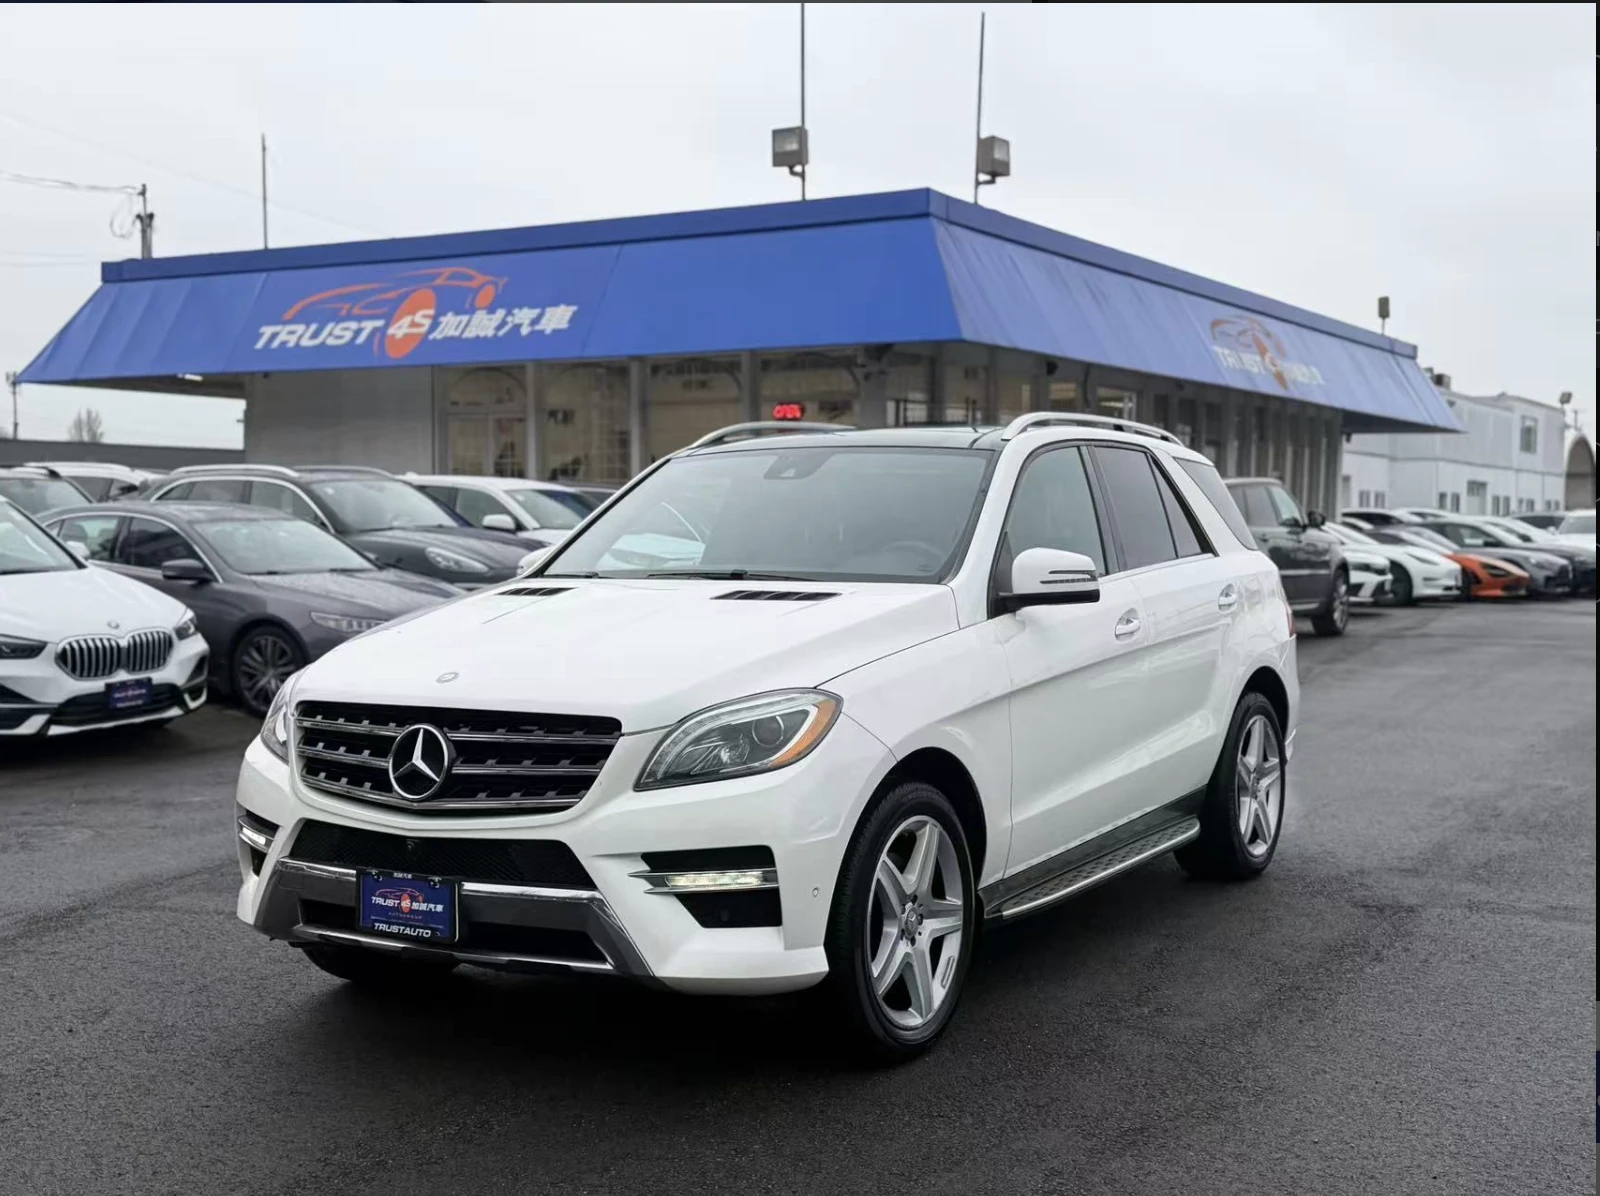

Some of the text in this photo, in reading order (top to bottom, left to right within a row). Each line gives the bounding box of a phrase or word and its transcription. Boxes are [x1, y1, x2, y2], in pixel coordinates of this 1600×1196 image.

[254, 304, 578, 350] TRUST 4S 加誠汽車
[371, 896, 400, 907] TRUST
[373, 922, 432, 938] TRUSTAUTO
